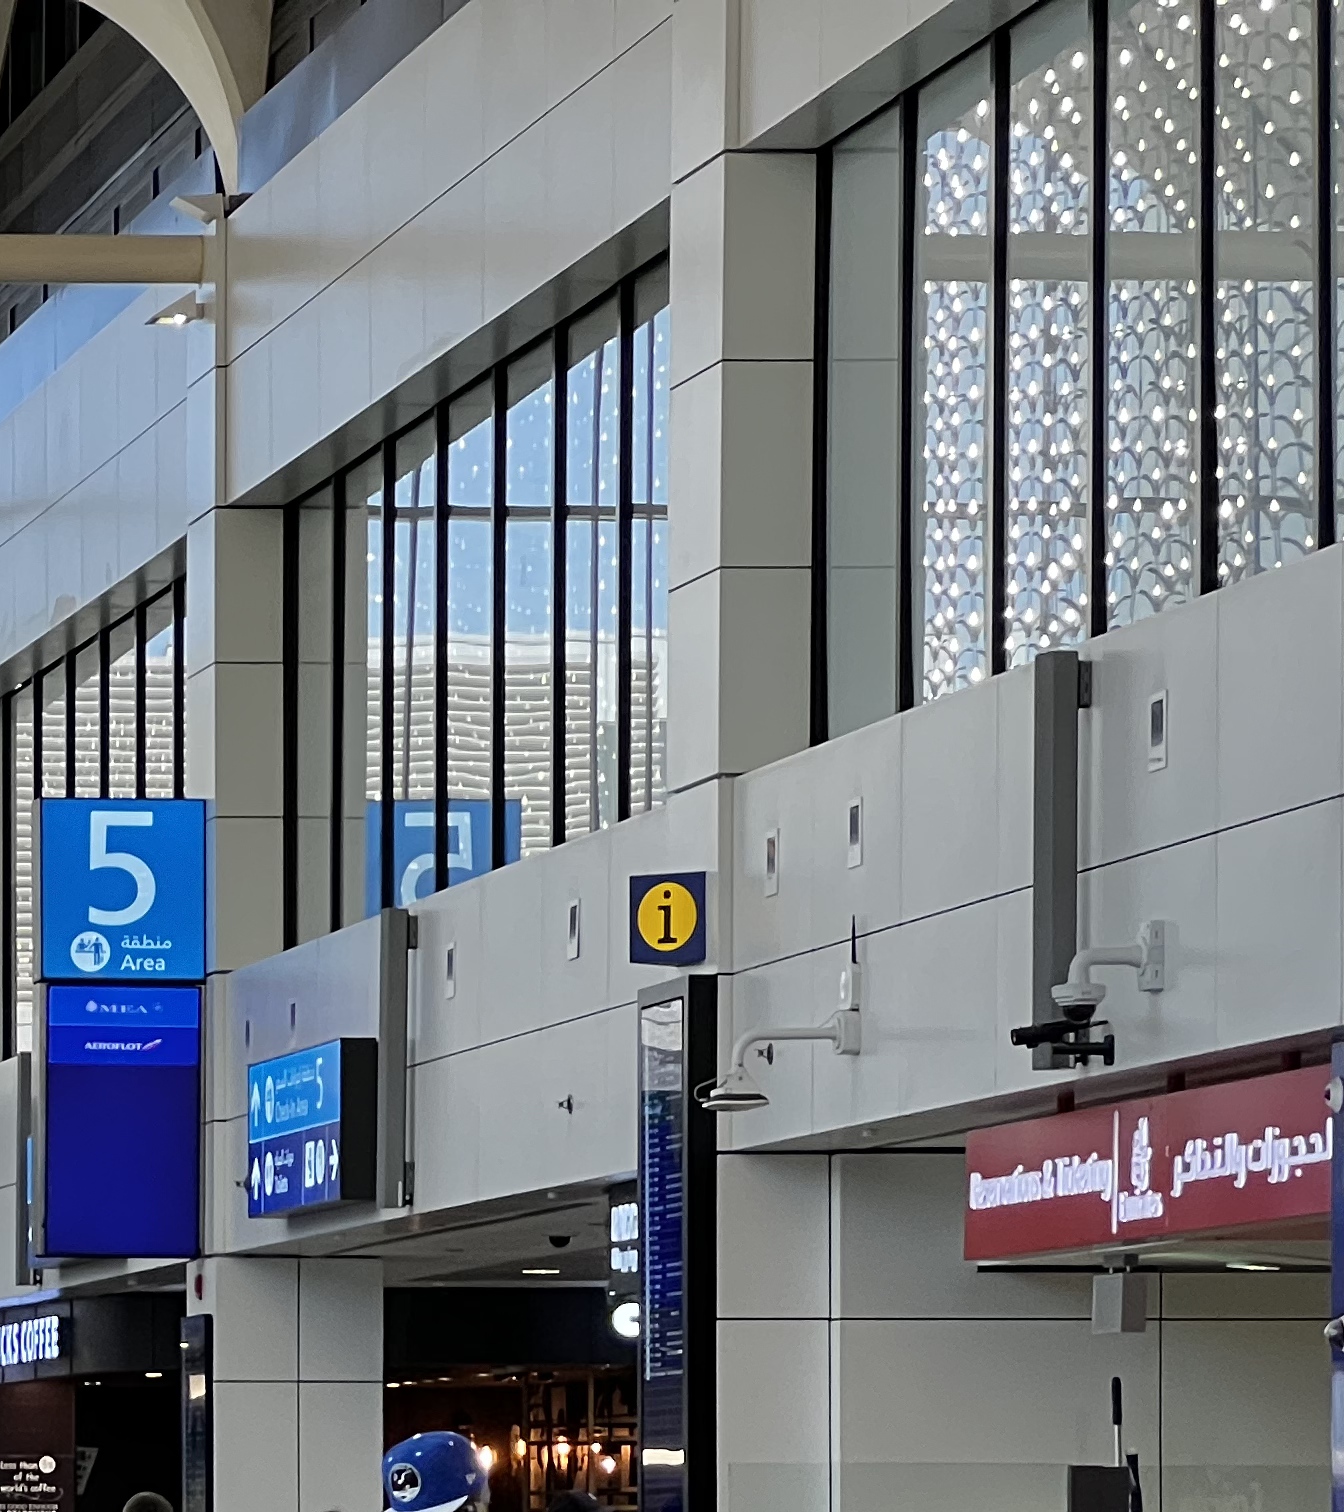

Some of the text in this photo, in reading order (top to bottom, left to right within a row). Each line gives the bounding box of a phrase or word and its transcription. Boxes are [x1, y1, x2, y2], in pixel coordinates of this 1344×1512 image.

[88, 810, 157, 926] 5
[120, 933, 173, 949] منطقة
[120, 954, 166, 971] Area
[84, 1041, 143, 1051] AEROFLOT
[315, 1057, 324, 1110] 5
[20, 1315, 60, 1364] COFFEE
